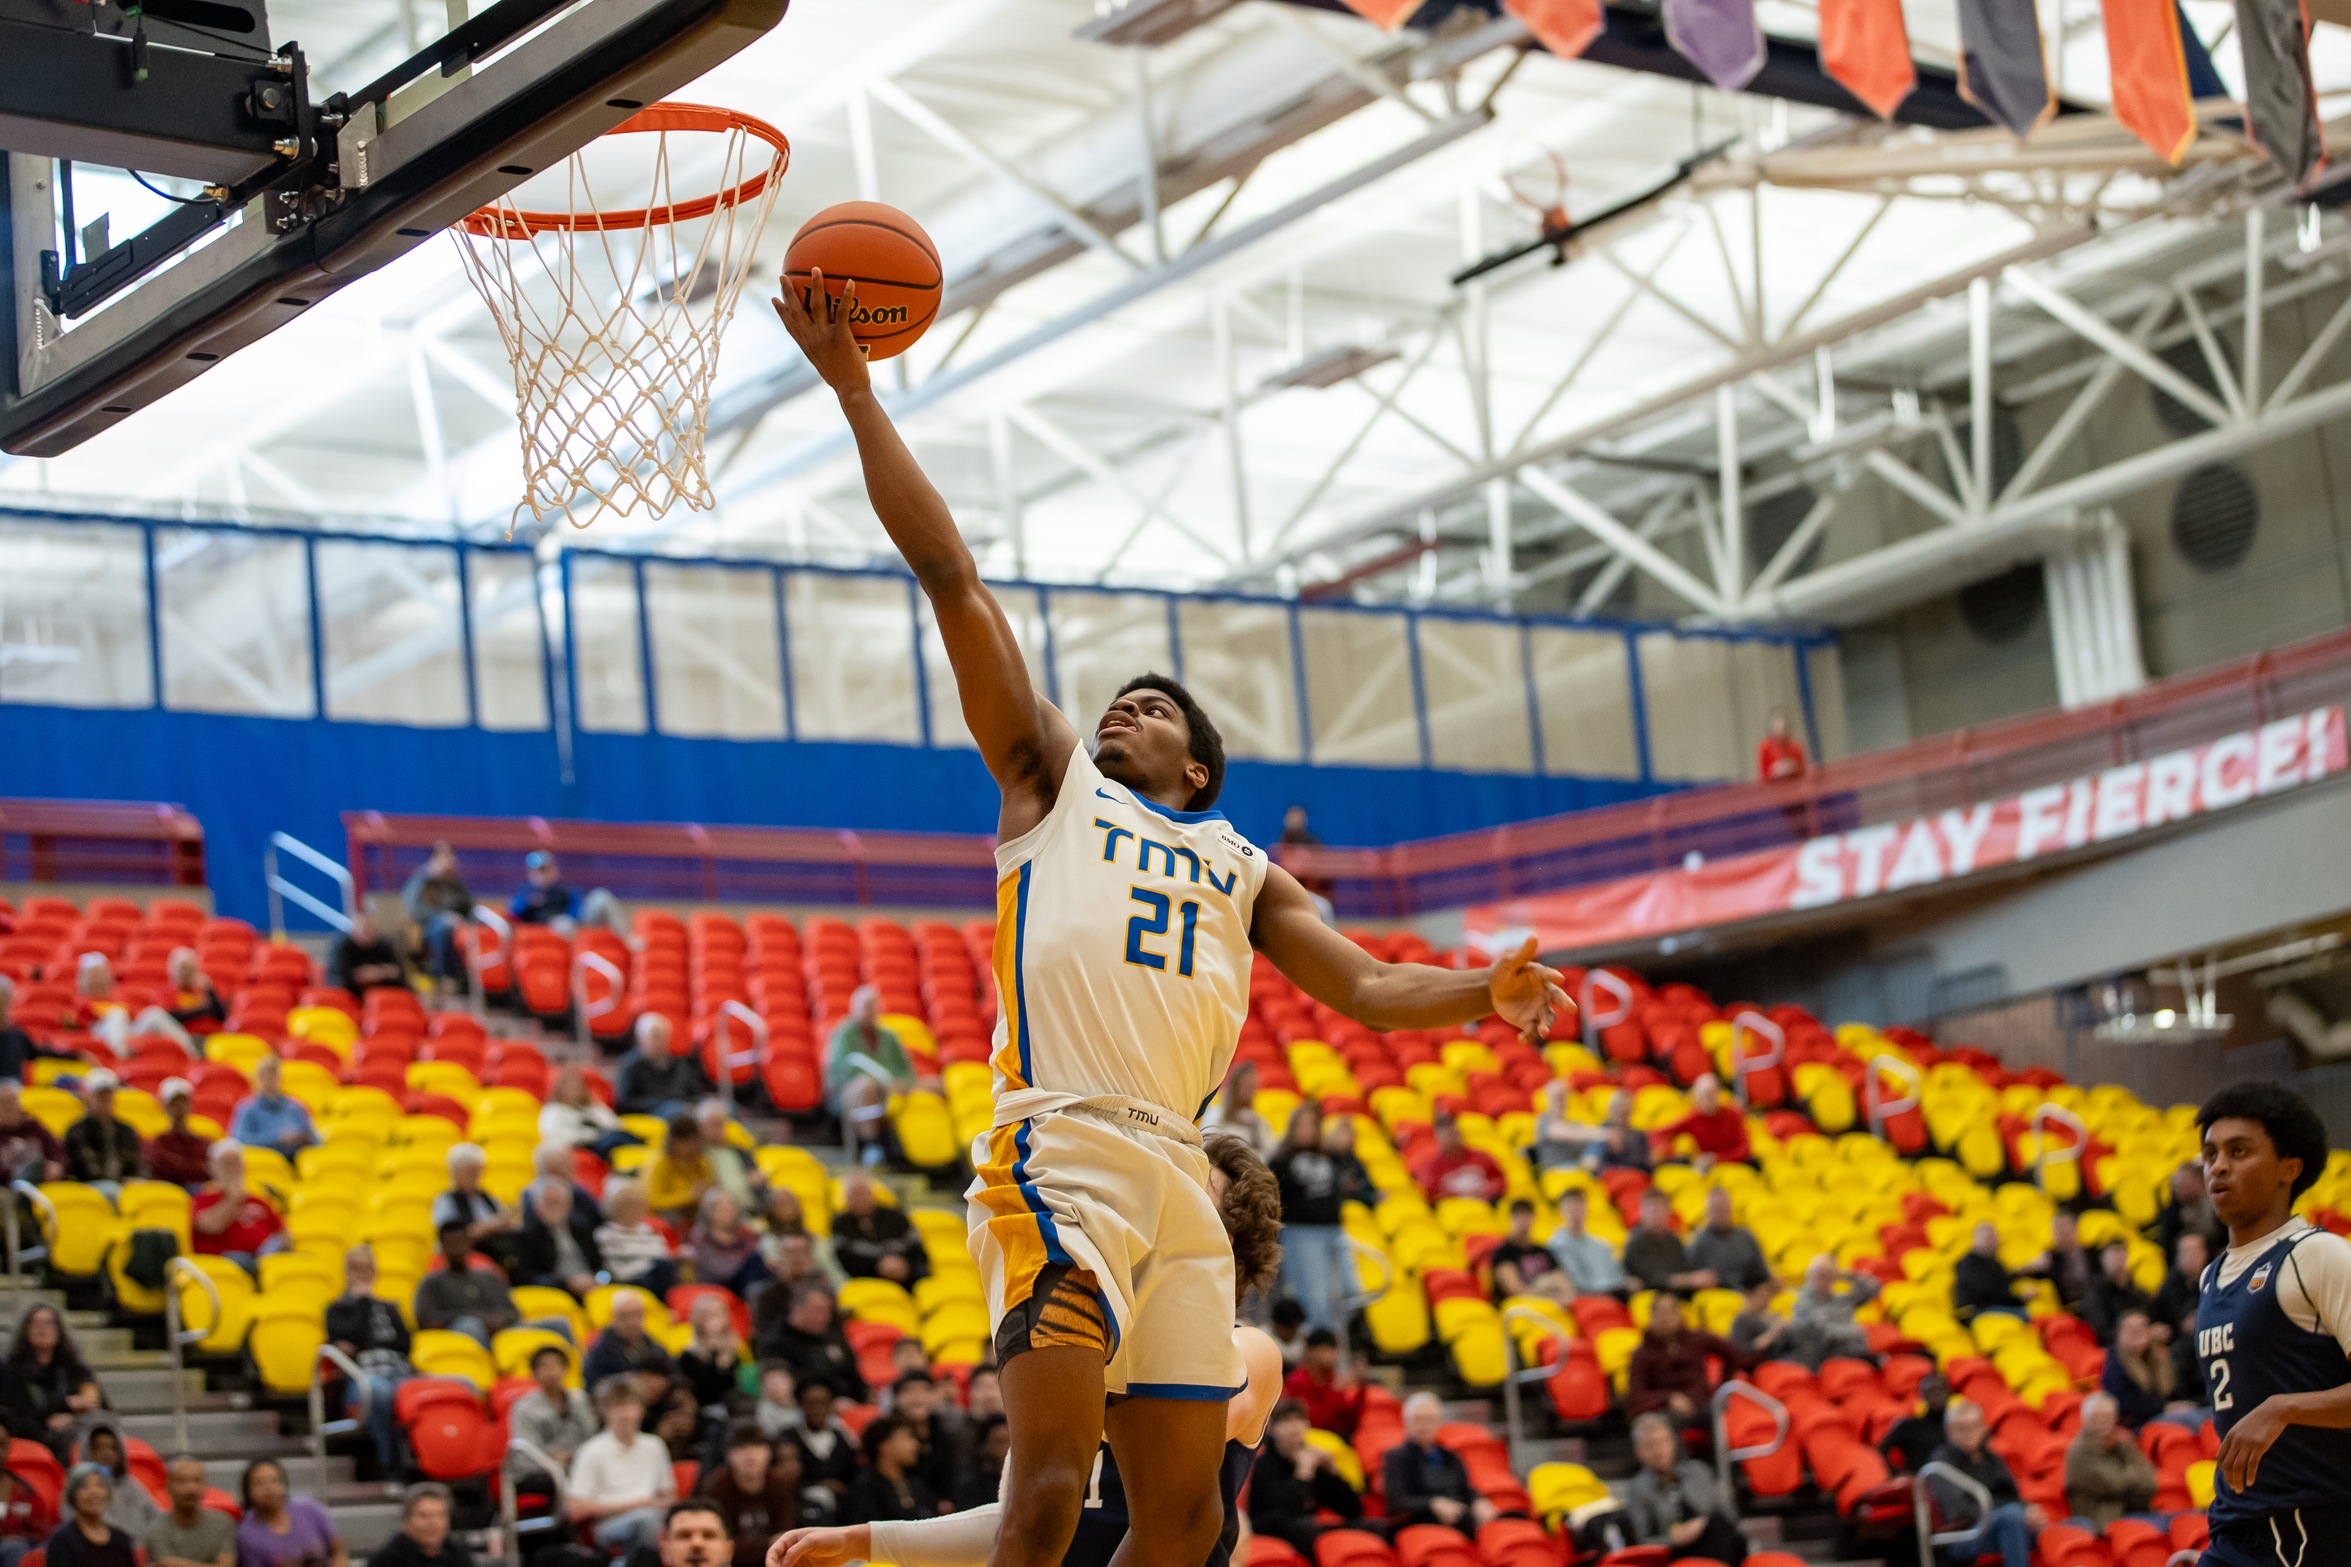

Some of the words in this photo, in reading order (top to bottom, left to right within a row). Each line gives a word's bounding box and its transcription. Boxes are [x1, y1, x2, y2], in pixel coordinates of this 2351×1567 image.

[1791, 802, 1993, 911] STAY
[2015, 705, 2329, 863] FIERCE!
[1092, 816, 1239, 897] TMU
[1221, 834, 1241, 849] BMO
[1123, 883, 1201, 981] 21
[1128, 1107, 1159, 1126] TMU
[2198, 1321, 2236, 1359] UBC
[2209, 1357, 2235, 1412] 2
